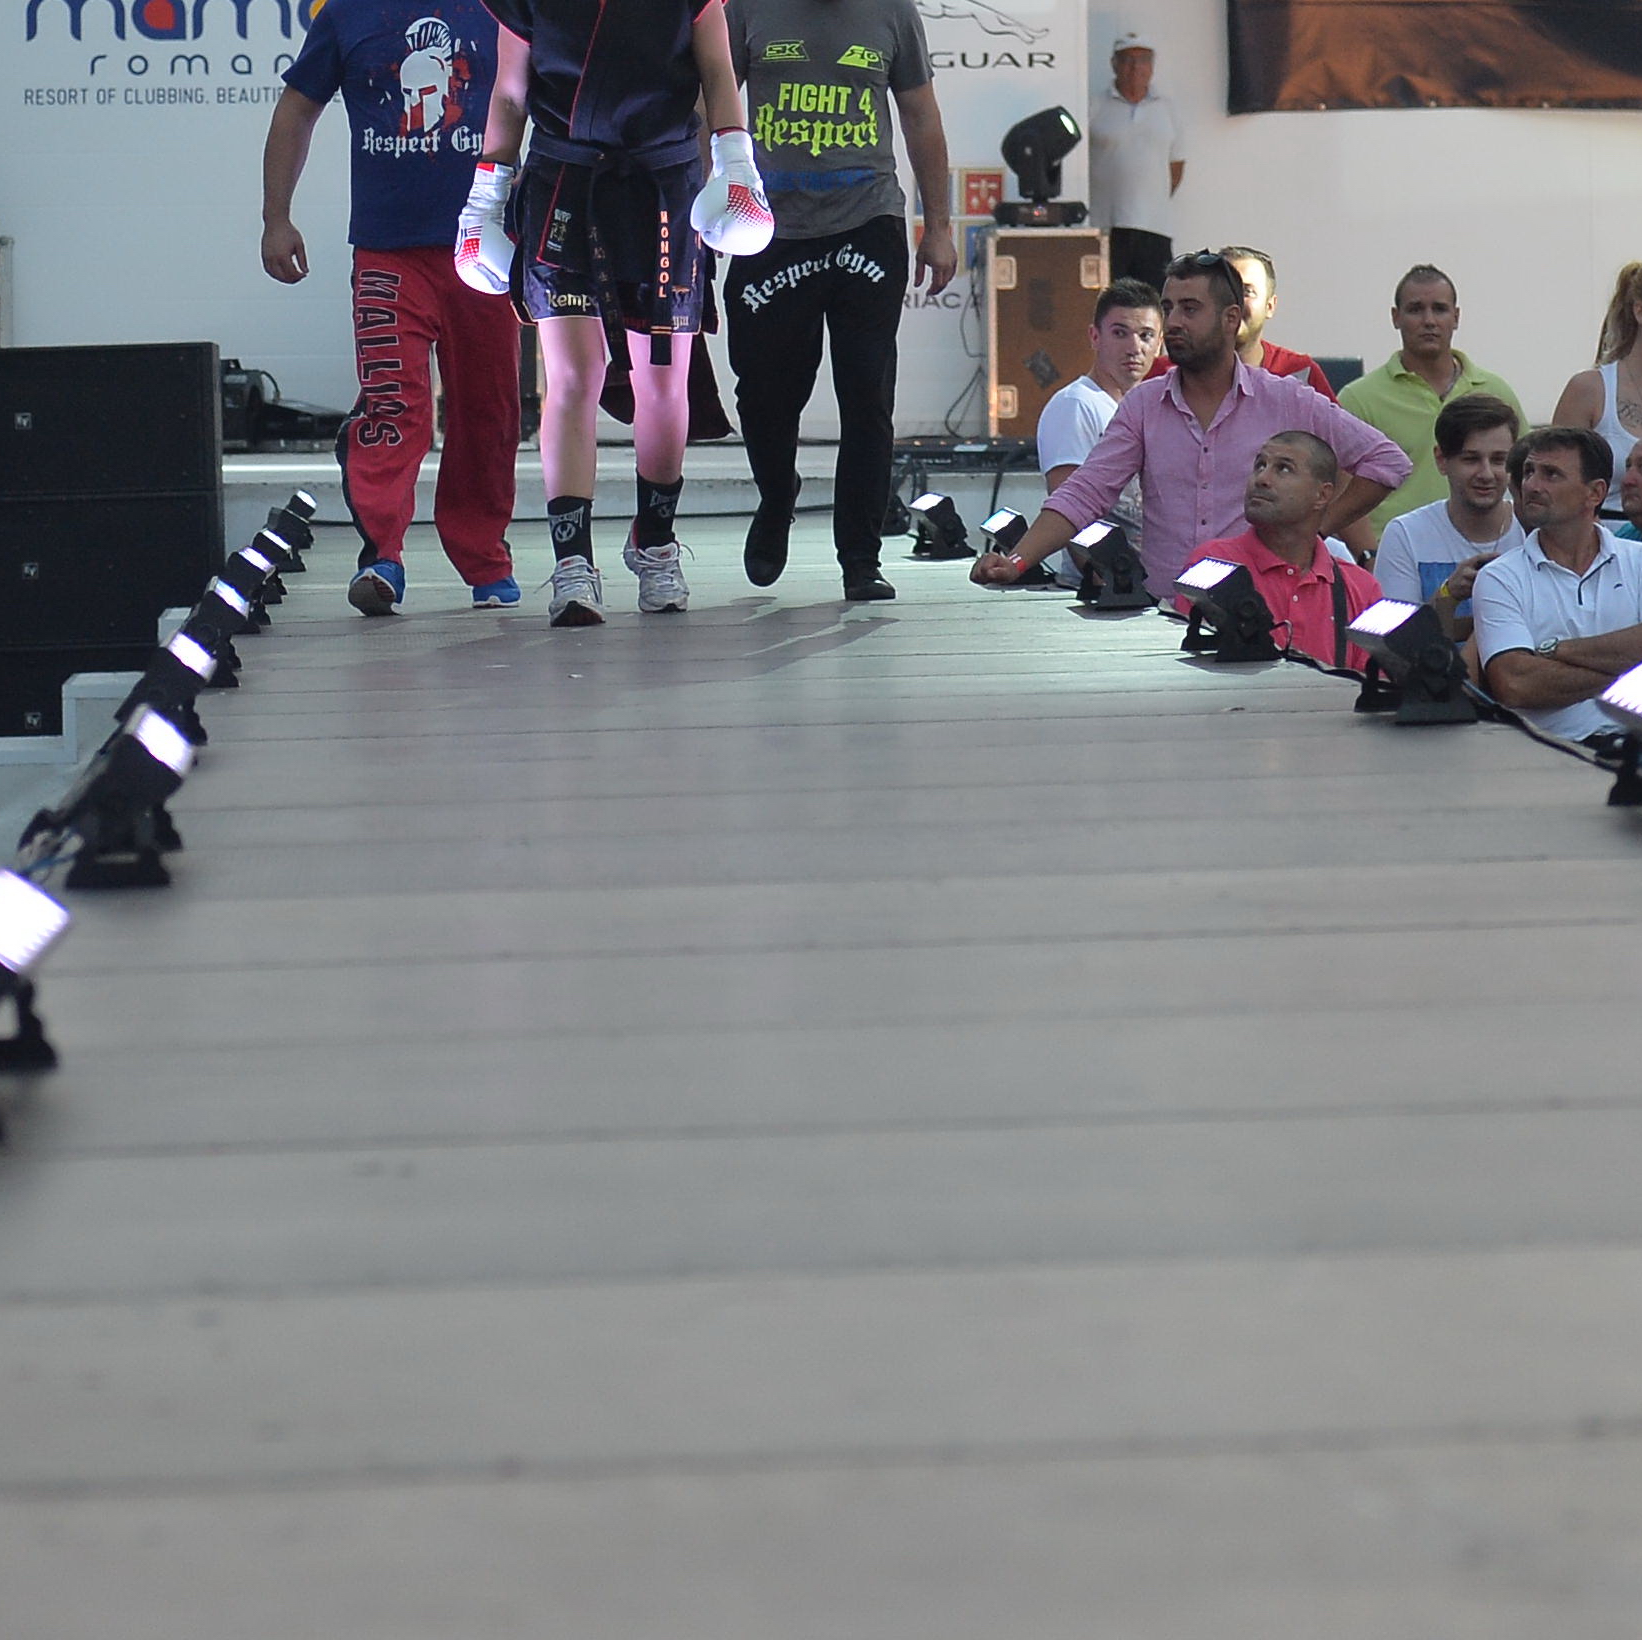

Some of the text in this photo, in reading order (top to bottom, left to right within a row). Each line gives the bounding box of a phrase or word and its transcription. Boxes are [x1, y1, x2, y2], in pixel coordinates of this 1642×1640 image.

[23, 88, 89, 106] RESORT
[95, 88, 117, 106] OF
[778, 82, 872, 116] FIGHT 4
[361, 126, 441, 159] Respect
[752, 102, 879, 158] Respect
[658, 210, 670, 298] MONGOL
[740, 243, 886, 314] Respect Gym
